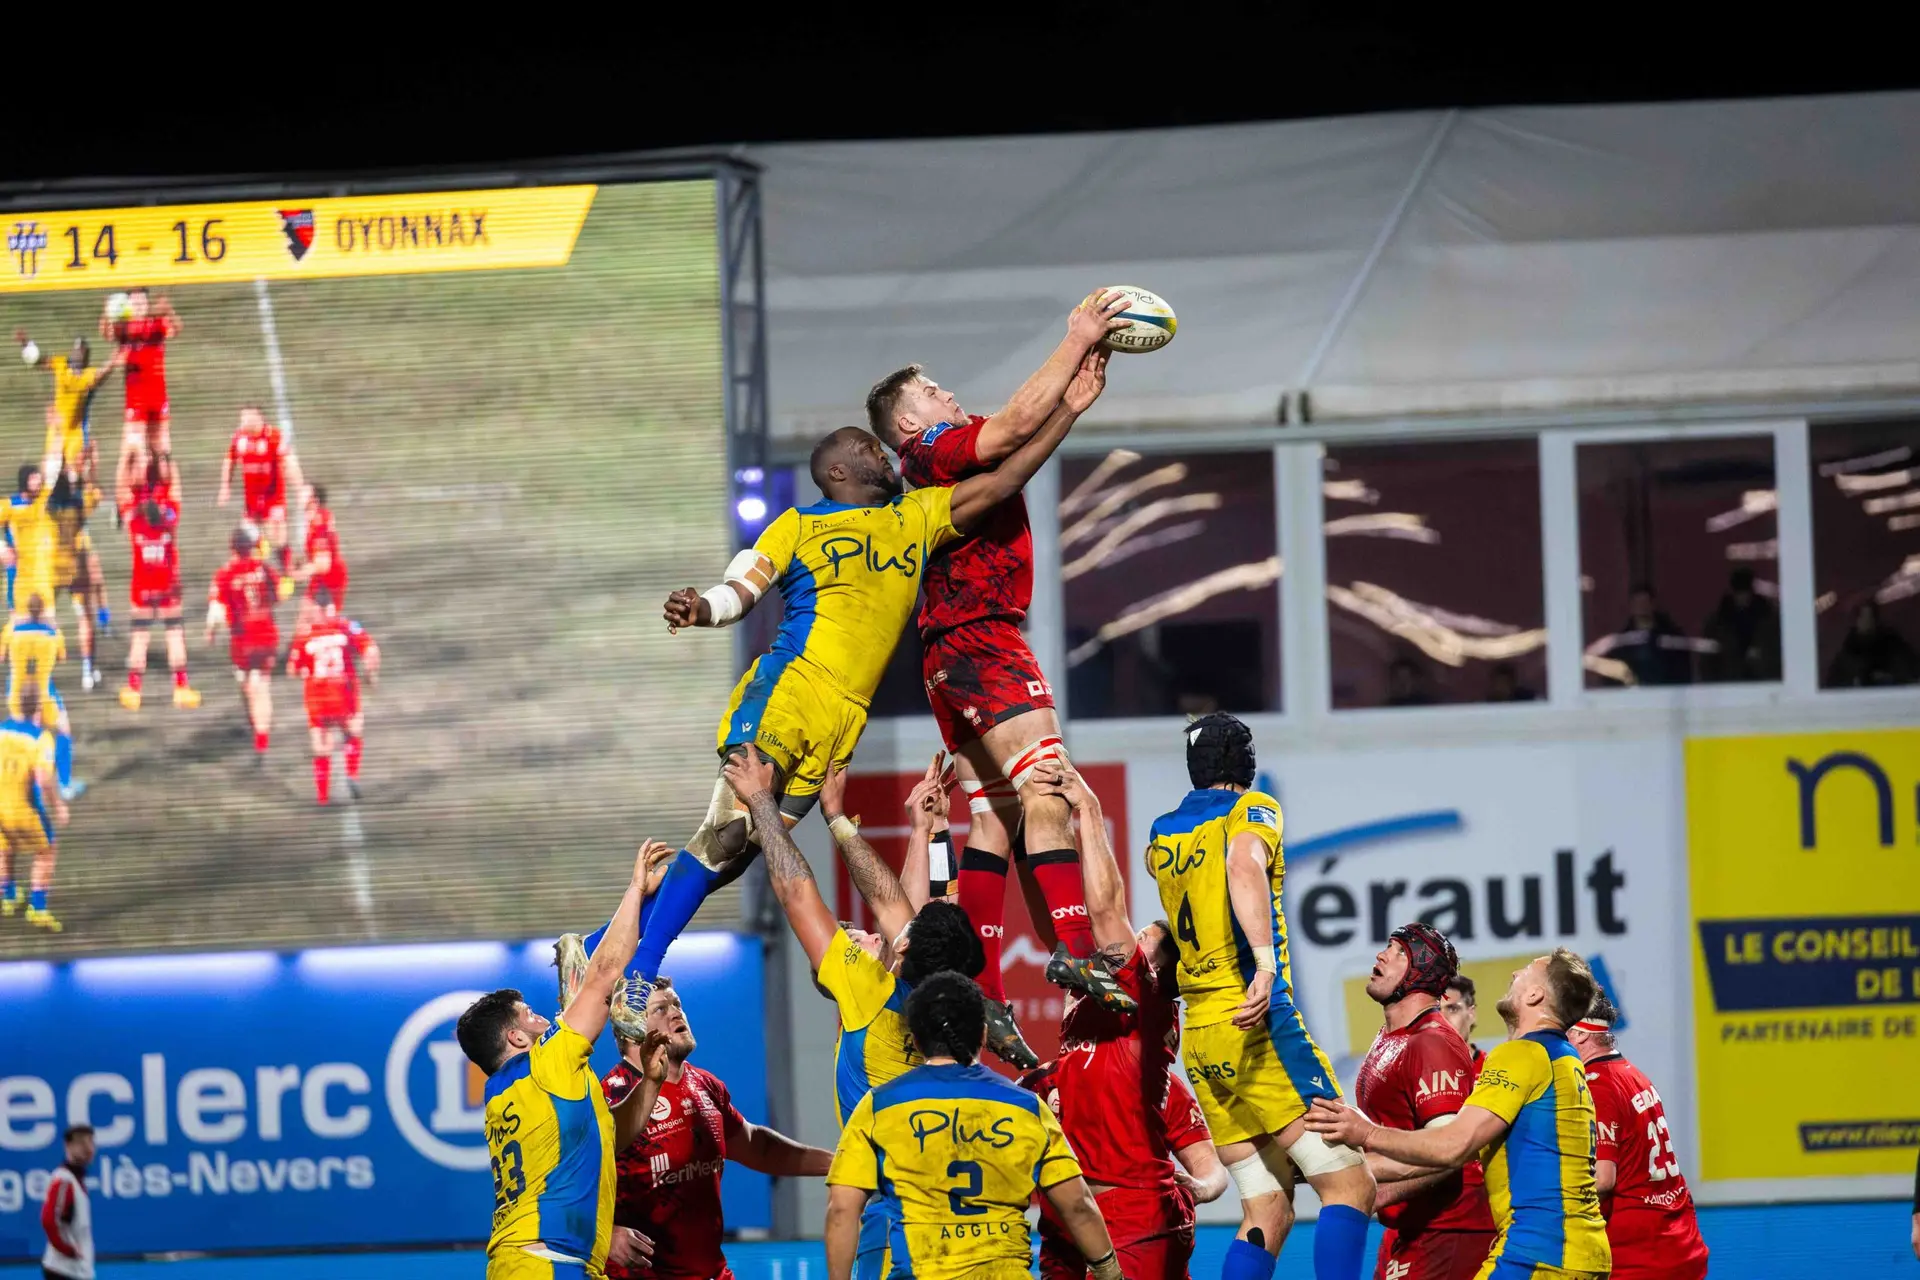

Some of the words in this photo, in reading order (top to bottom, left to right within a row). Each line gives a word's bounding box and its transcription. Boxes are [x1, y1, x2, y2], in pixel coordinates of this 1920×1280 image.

[64, 225, 118, 268] 14
[172, 219, 226, 263] 16
[336, 211, 489, 252] OYONNAX
[821, 534, 917, 578] Plus
[1177, 890, 1200, 951] 4
[1725, 933, 1763, 963] LE
[1772, 927, 1918, 964] CONSEIL
[1856, 968, 1901, 999] DE
[1720, 1015, 1874, 1044] PARTENAIRE
[1882, 1015, 1916, 1038] DE
[1416, 1070, 1459, 1097] AIN
[909, 1107, 1014, 1153] Plus
[1647, 1116, 1680, 1181] 23
[947, 1160, 988, 1216] 2
[940, 1221, 1010, 1239] AGGLO
